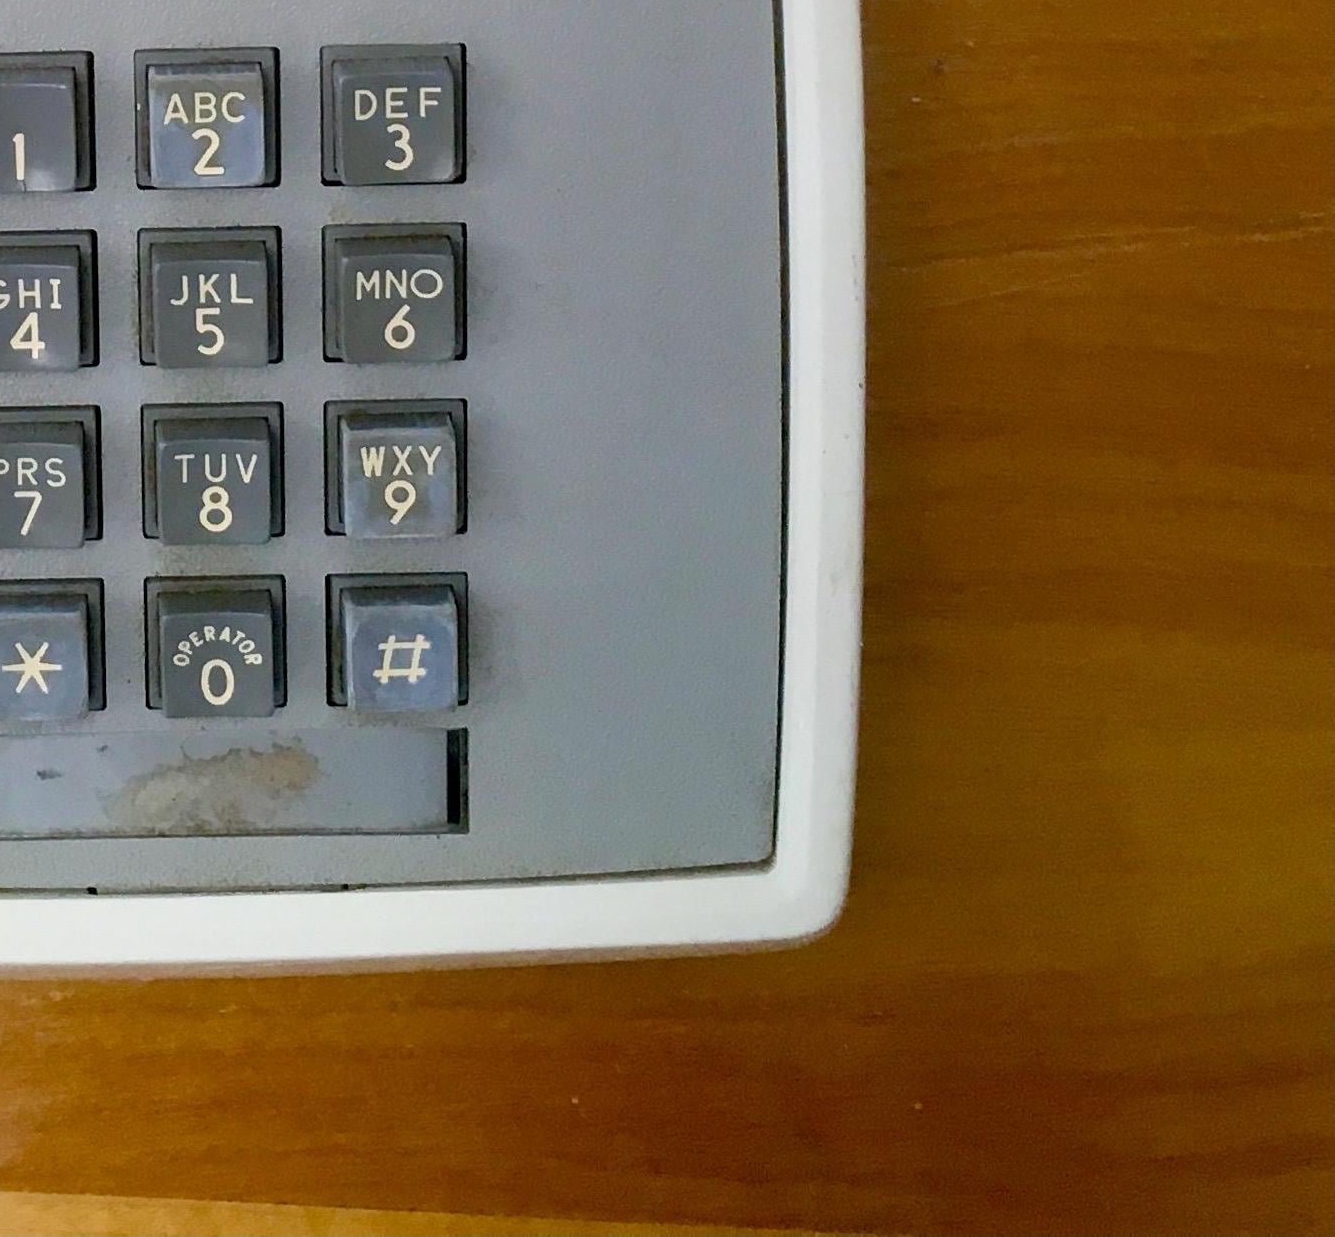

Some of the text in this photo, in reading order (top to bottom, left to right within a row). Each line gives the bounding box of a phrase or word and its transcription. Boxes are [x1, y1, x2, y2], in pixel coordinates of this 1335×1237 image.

[164, 91, 246, 124] ABC
[354, 87, 442, 119] DEF
[12, 133, 25, 180] 1
[192, 128, 224, 174] 2
[384, 123, 414, 171] 3
[170, 273, 254, 306] JKL
[356, 269, 444, 301] MNO
[9, 311, 46, 359] 4
[195, 307, 225, 355] 5
[383, 305, 416, 351] 6
[174, 453, 258, 484] TUV
[360, 445, 442, 478] WXY
[13, 490, 43, 535] 7
[198, 485, 233, 532] 8
[384, 479, 416, 525] 9
[172, 625, 263, 667] OPERATOR
[372, 633, 431, 685] #
[201, 658, 235, 706] 0
